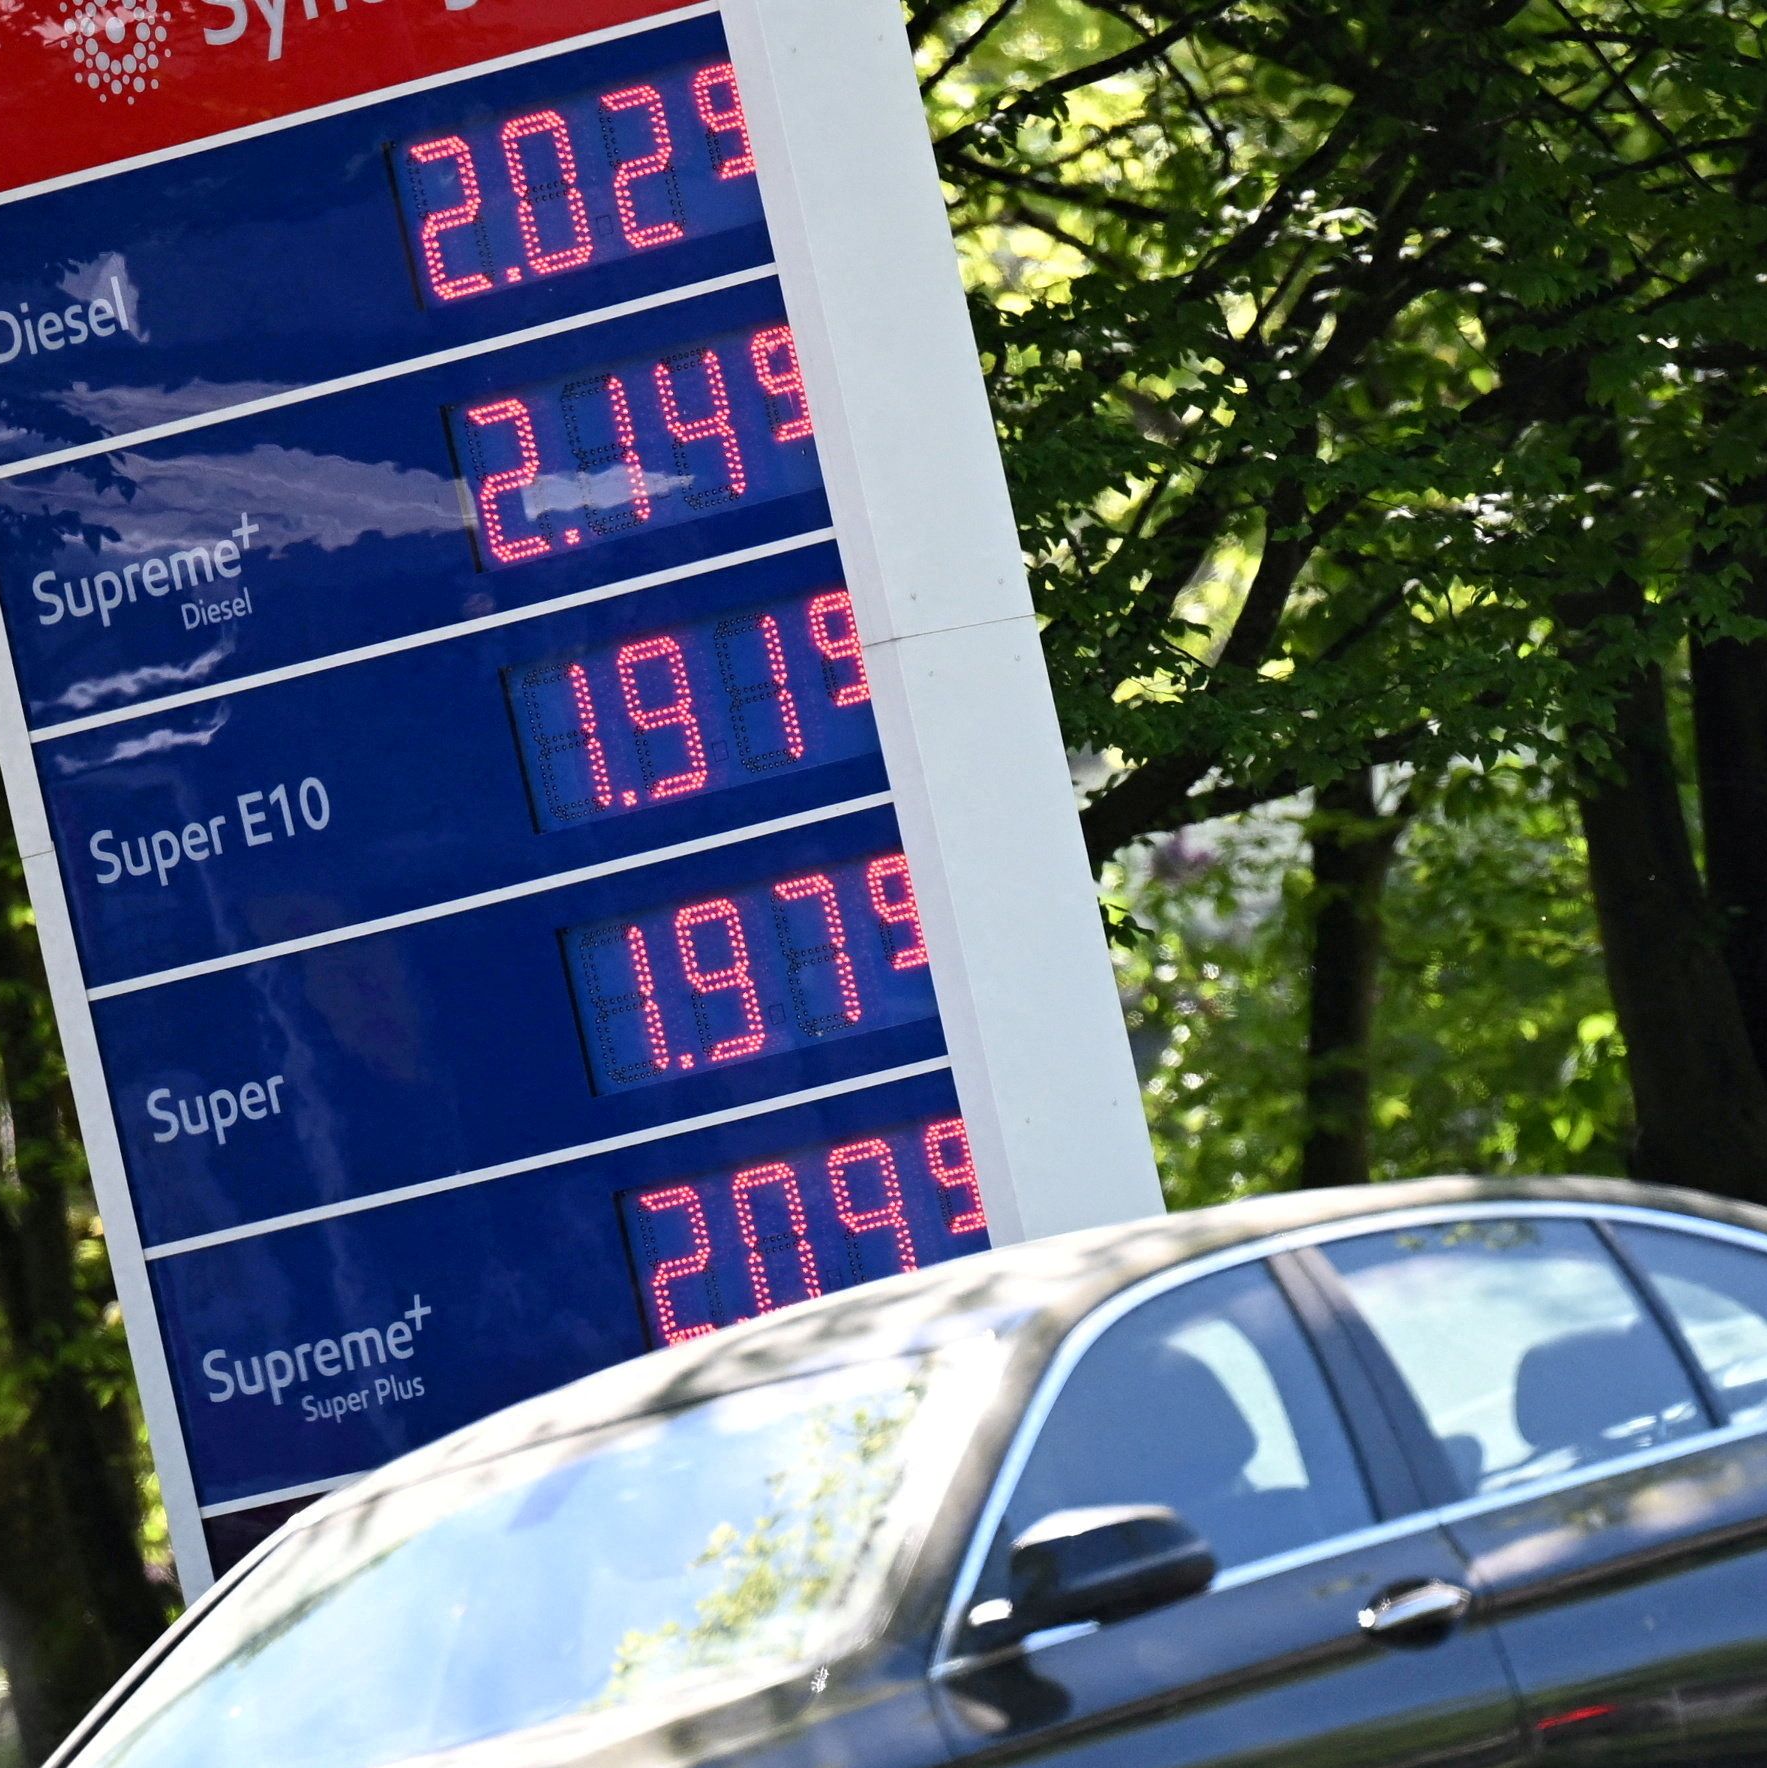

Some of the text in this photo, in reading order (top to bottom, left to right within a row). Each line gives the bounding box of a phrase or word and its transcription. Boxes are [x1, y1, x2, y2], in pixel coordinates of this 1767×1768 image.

[181, 587, 253, 630] Diesel
[89, 776, 330, 887] Super E10
[146, 1075, 284, 1145] Super
[301, 1374, 426, 1424] Super Plus
